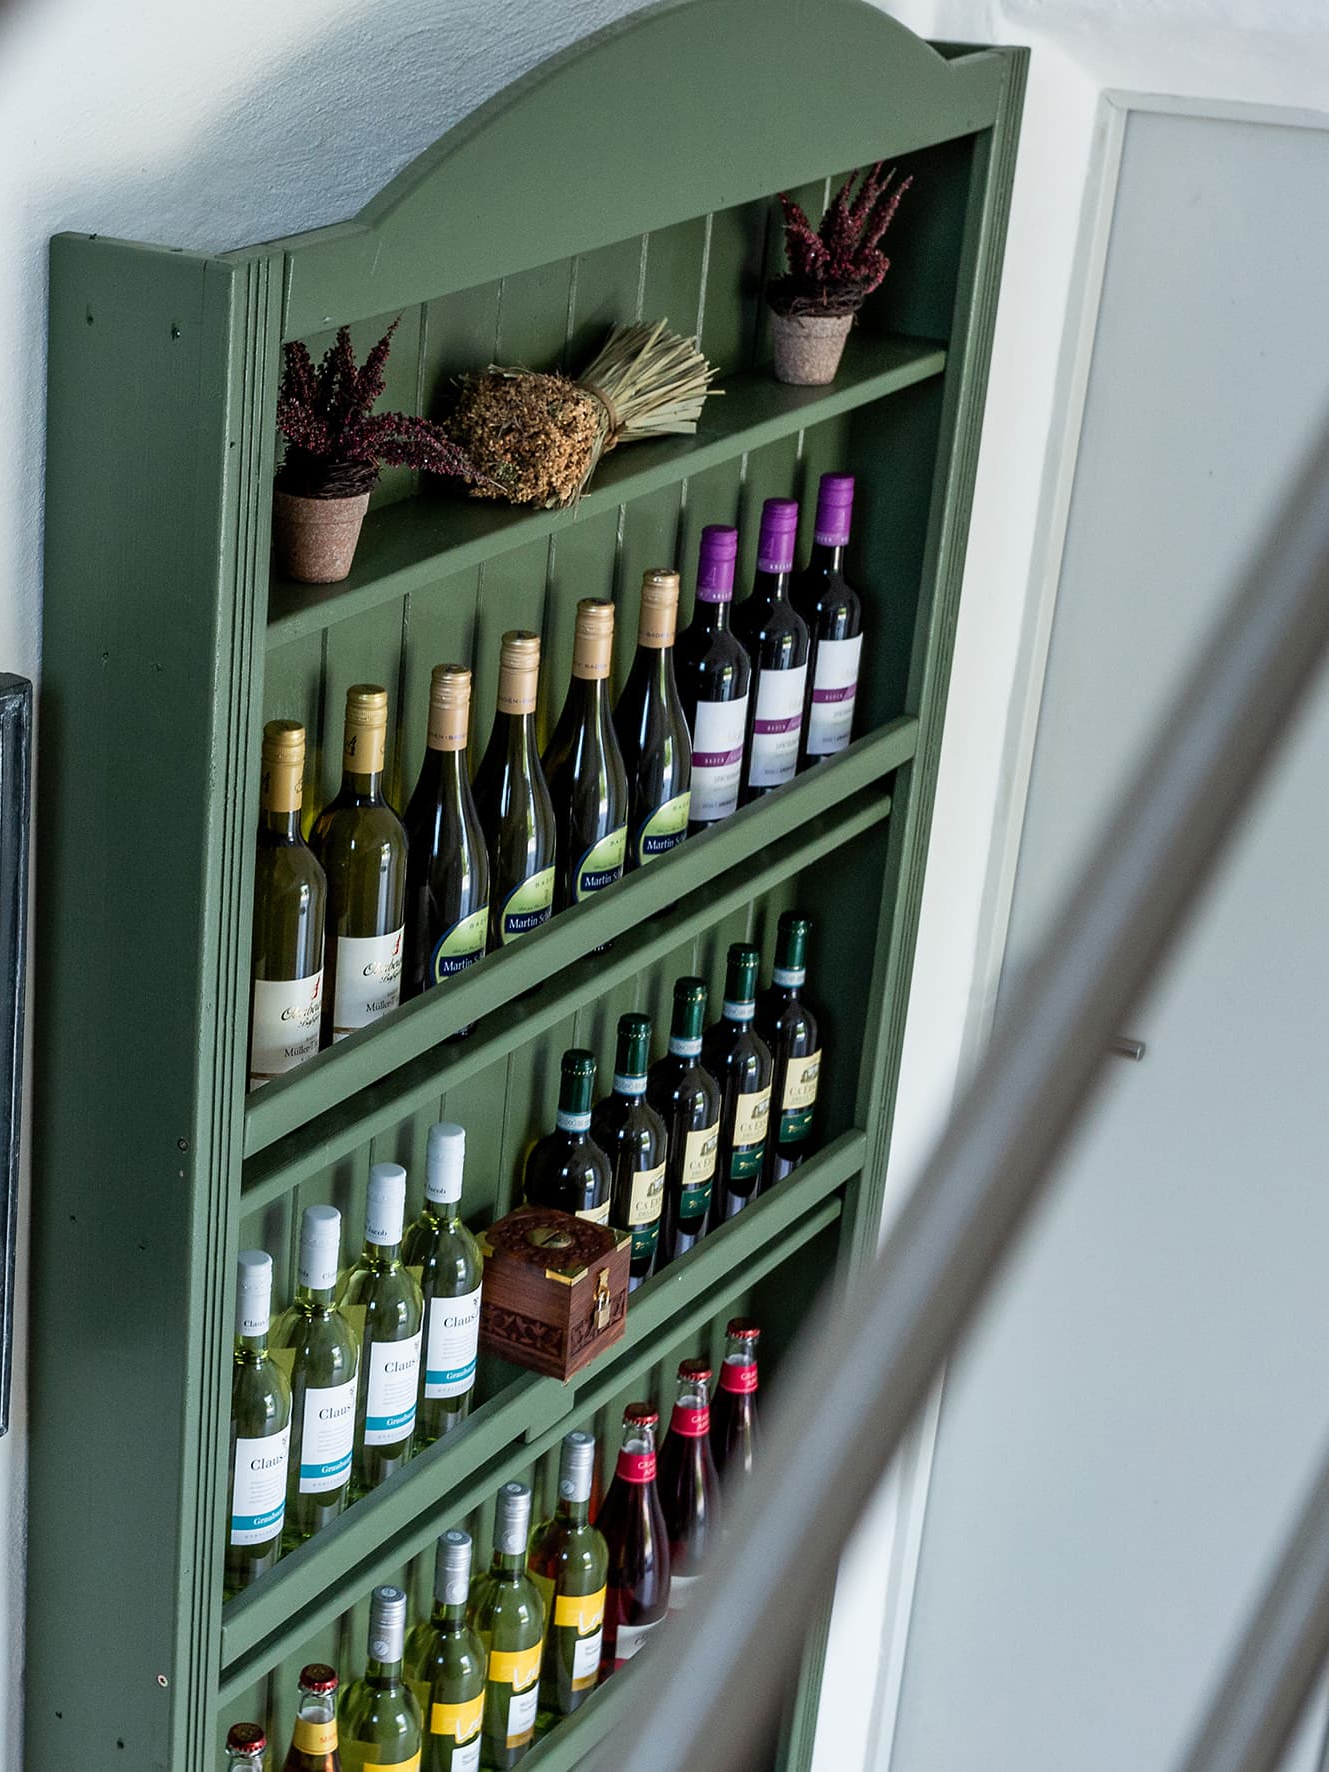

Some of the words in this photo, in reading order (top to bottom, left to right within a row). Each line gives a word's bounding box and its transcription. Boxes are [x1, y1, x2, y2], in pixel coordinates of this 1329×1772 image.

[646, 838, 675, 850] Martin
[584, 873, 612, 887] Martin
[509, 915, 538, 929] Martin
[443, 957, 473, 972] Martin
